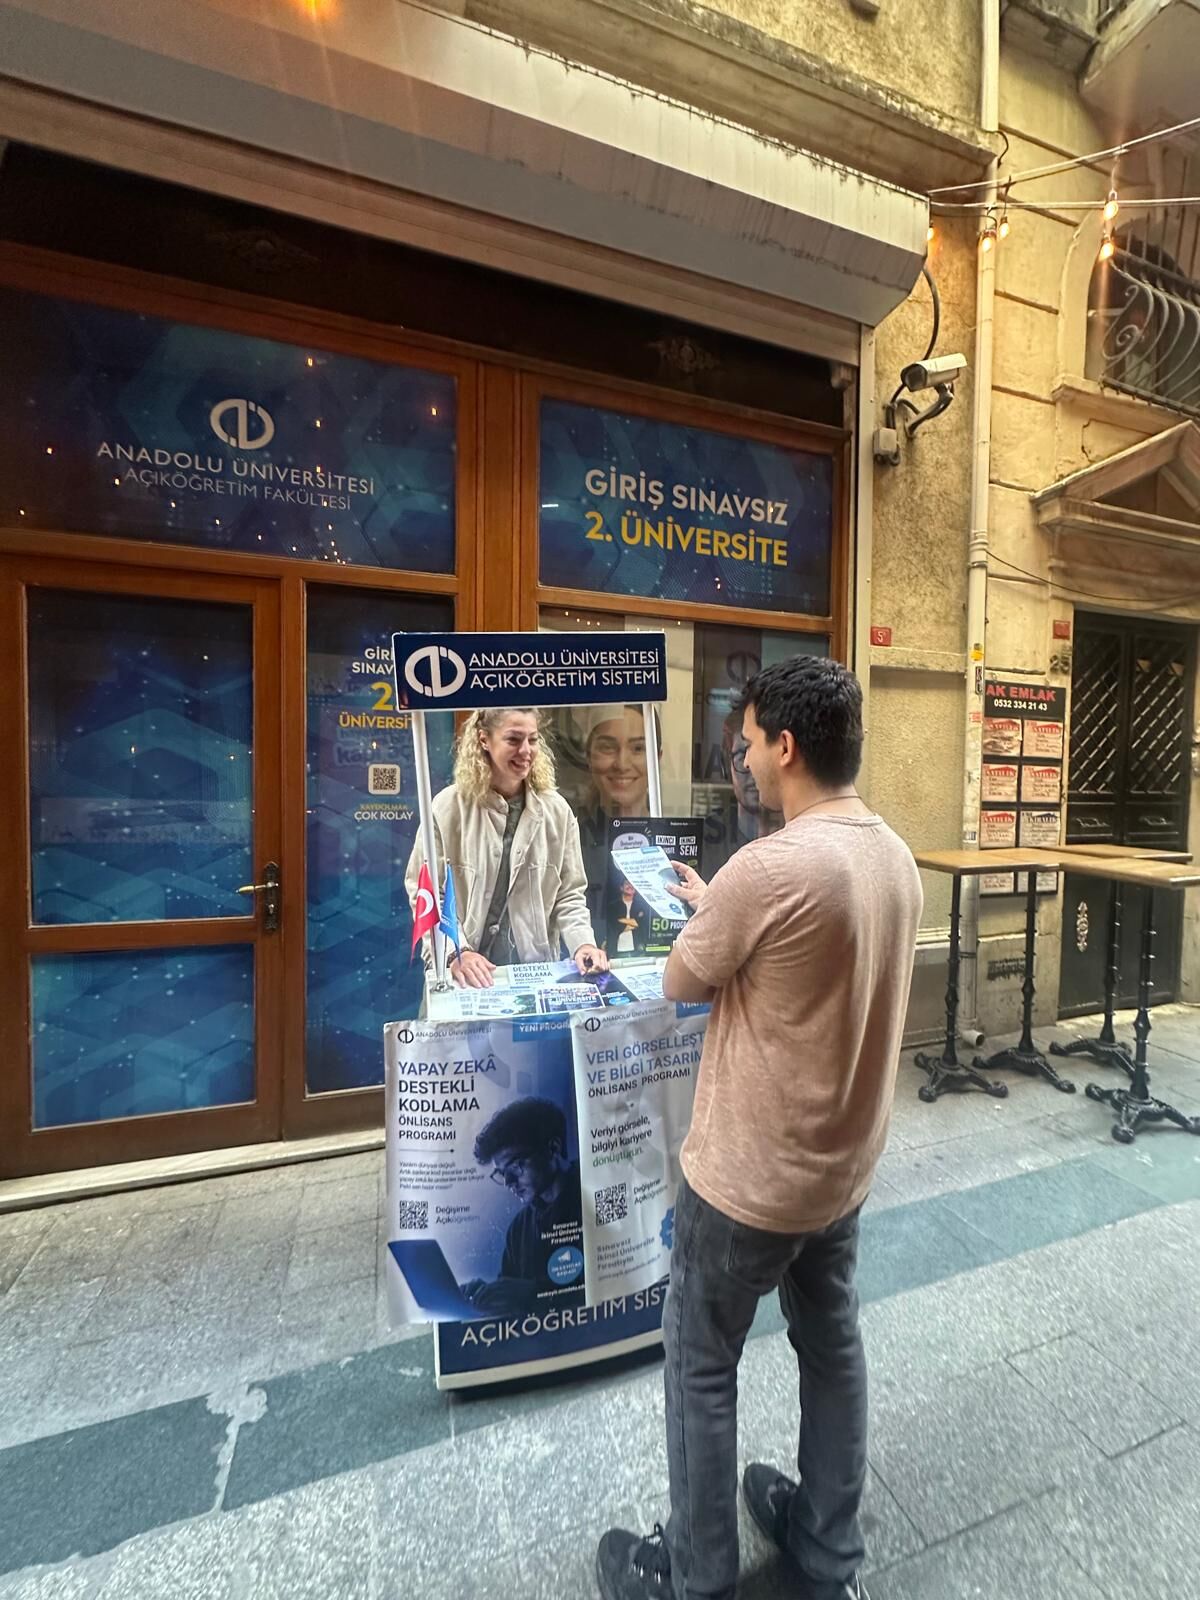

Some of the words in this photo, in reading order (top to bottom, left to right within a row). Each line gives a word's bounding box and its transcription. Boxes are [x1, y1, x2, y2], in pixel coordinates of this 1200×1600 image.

[97, 441, 223, 473] ANADOLU
[232, 457, 374, 496] ÜNİVERSİTESİ
[124, 467, 258, 499] AÇIKÖĞRETİM
[264, 485, 351, 510] FAKÜLTESİ
[585, 466, 664, 511] GİRİŞ
[672, 484, 788, 526] SINAVSIZ
[585, 511, 613, 543] 2.
[621, 509, 788, 566] ÜNİVERSİTE
[364, 646, 394, 661] GİRİ
[469, 651, 555, 668] ANADOLU
[561, 648, 659, 666] ÜNİVERSİTESİ
[352, 662, 396, 675] SINAV
[470, 669, 596, 692] AÇIKÖĞRETİM
[602, 668, 660, 686] SİSTEMİ
[986, 684, 1006, 697] AK
[1009, 686, 1056, 702] EMLAK
[994, 698, 1012, 708] 0532
[1013, 700, 1027, 709] 334
[1028, 702, 1037, 710] 21
[1038, 703, 1048, 711] 43
[339, 711, 412, 729] ÜNİVERSİ
[354, 811, 379, 823] ÇOK
[380, 811, 414, 821] KOLAY
[680, 845, 698, 857] SEN!
[652, 918, 669, 931] 50
[587, 1046, 618, 1066] VERİ
[623, 1031, 704, 1060] GÖRSELLEŞT
[398, 1061, 448, 1076] YAPAY
[454, 1054, 497, 1075] ZEKÂ
[587, 1070, 606, 1085] VE
[610, 1059, 643, 1080] BİLGİ
[399, 1076, 475, 1094] DESTEKLİ
[588, 1079, 638, 1098] ÖNLİSANS
[641, 1068, 690, 1087] PROGRAMI
[399, 1098, 480, 1113] KODLAMA
[399, 1115, 453, 1127] ÖNLİSANS
[399, 1130, 456, 1140] PROGRAMI
[591, 1125, 616, 1139] Veriyi
[461, 1294, 627, 1347] AÇIKÖĞRETİM
